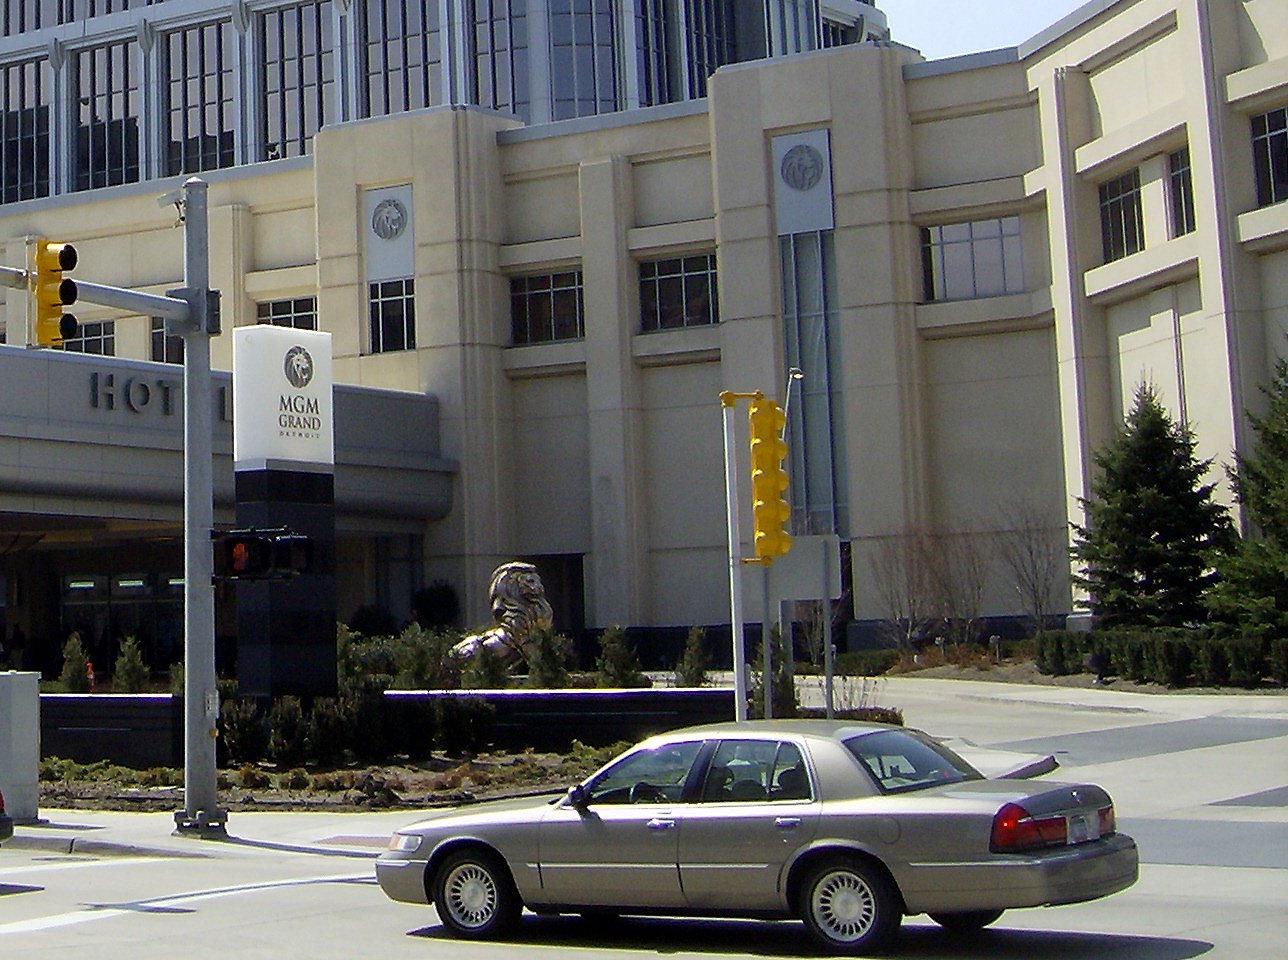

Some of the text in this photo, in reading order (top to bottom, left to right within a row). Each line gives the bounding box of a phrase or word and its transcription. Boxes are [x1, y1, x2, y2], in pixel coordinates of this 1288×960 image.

[89, 371, 233, 422] HOTL
[279, 395, 320, 415] MGM
[278, 414, 321, 431] GRAND
